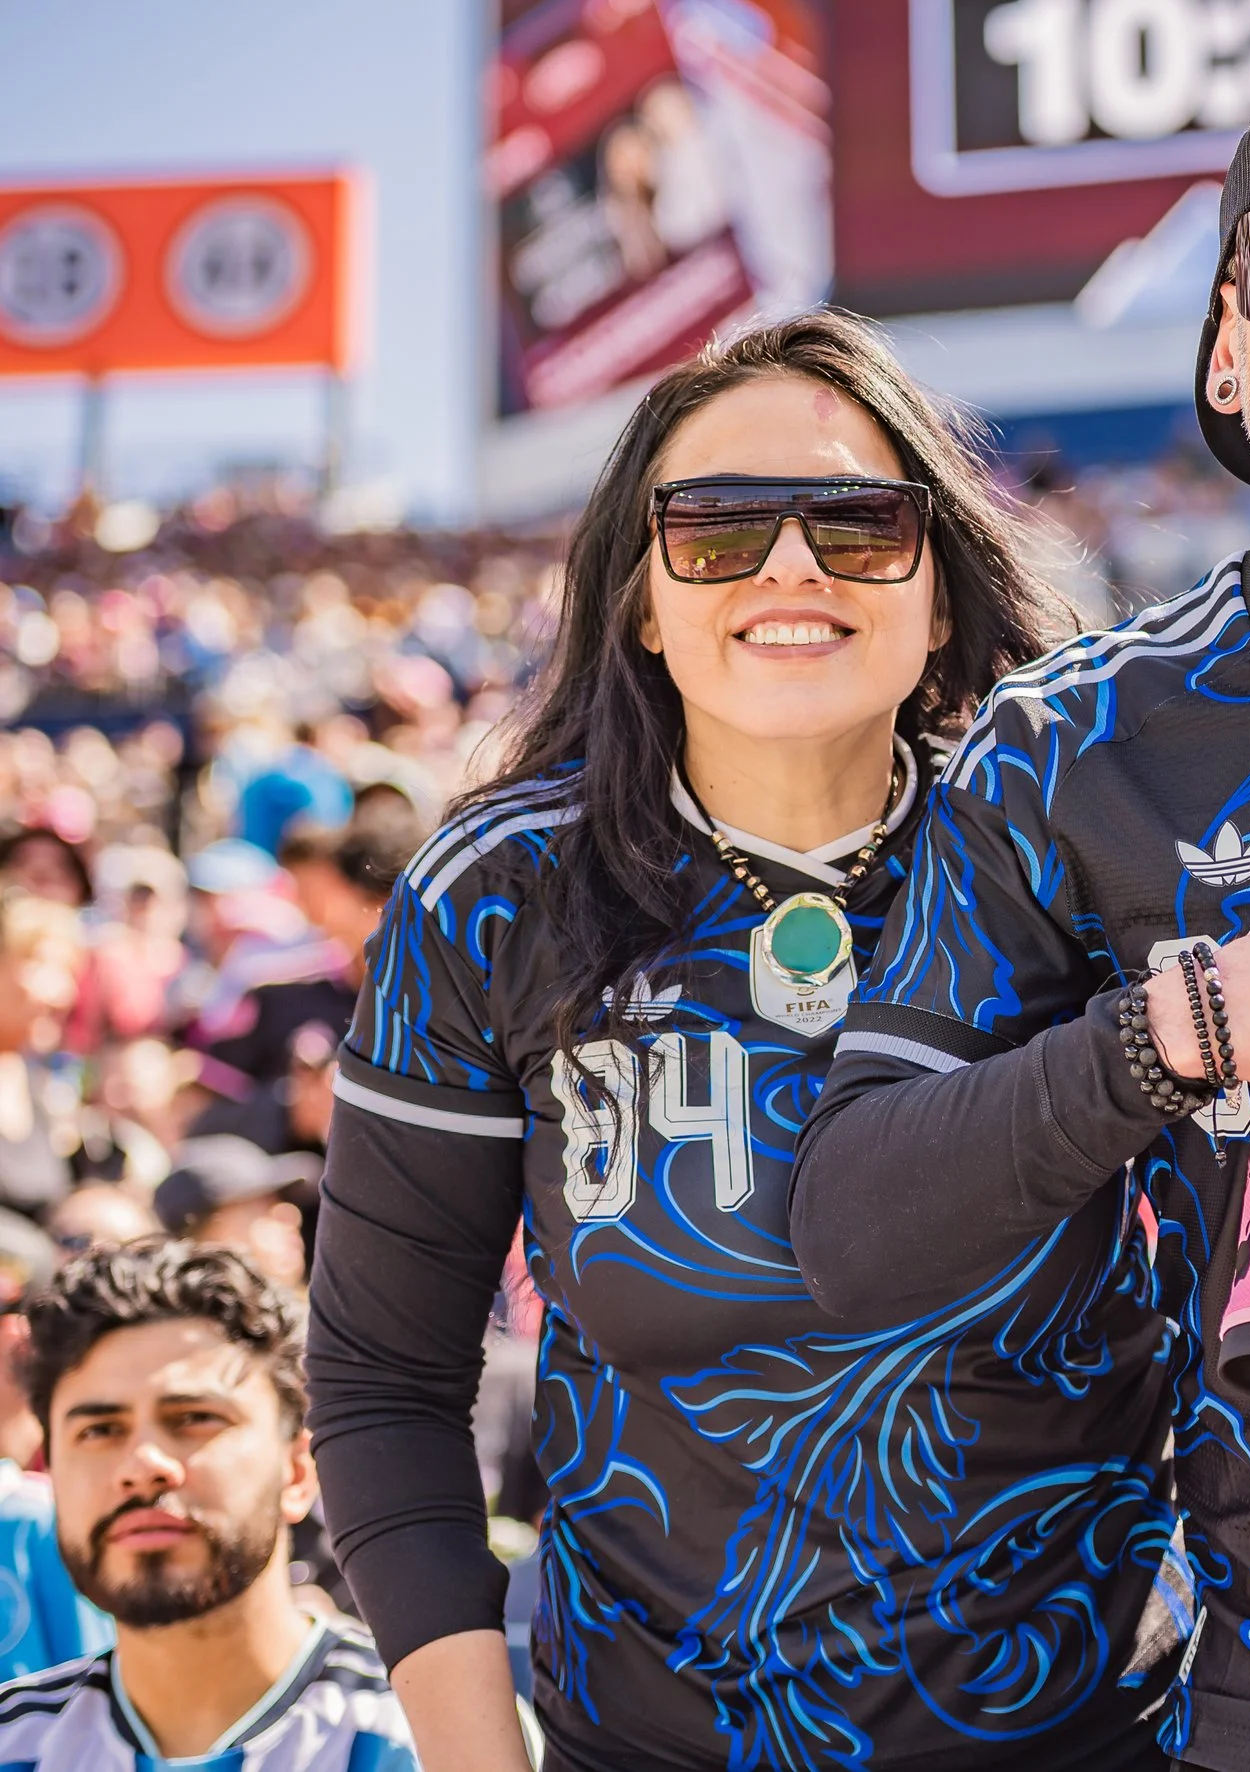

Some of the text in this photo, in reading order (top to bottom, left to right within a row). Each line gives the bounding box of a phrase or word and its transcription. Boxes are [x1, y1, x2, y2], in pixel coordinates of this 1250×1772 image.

[785, 999, 831, 1013] FIFA
[795, 1016, 823, 1024] 2022
[550, 1031, 754, 1223] 84
